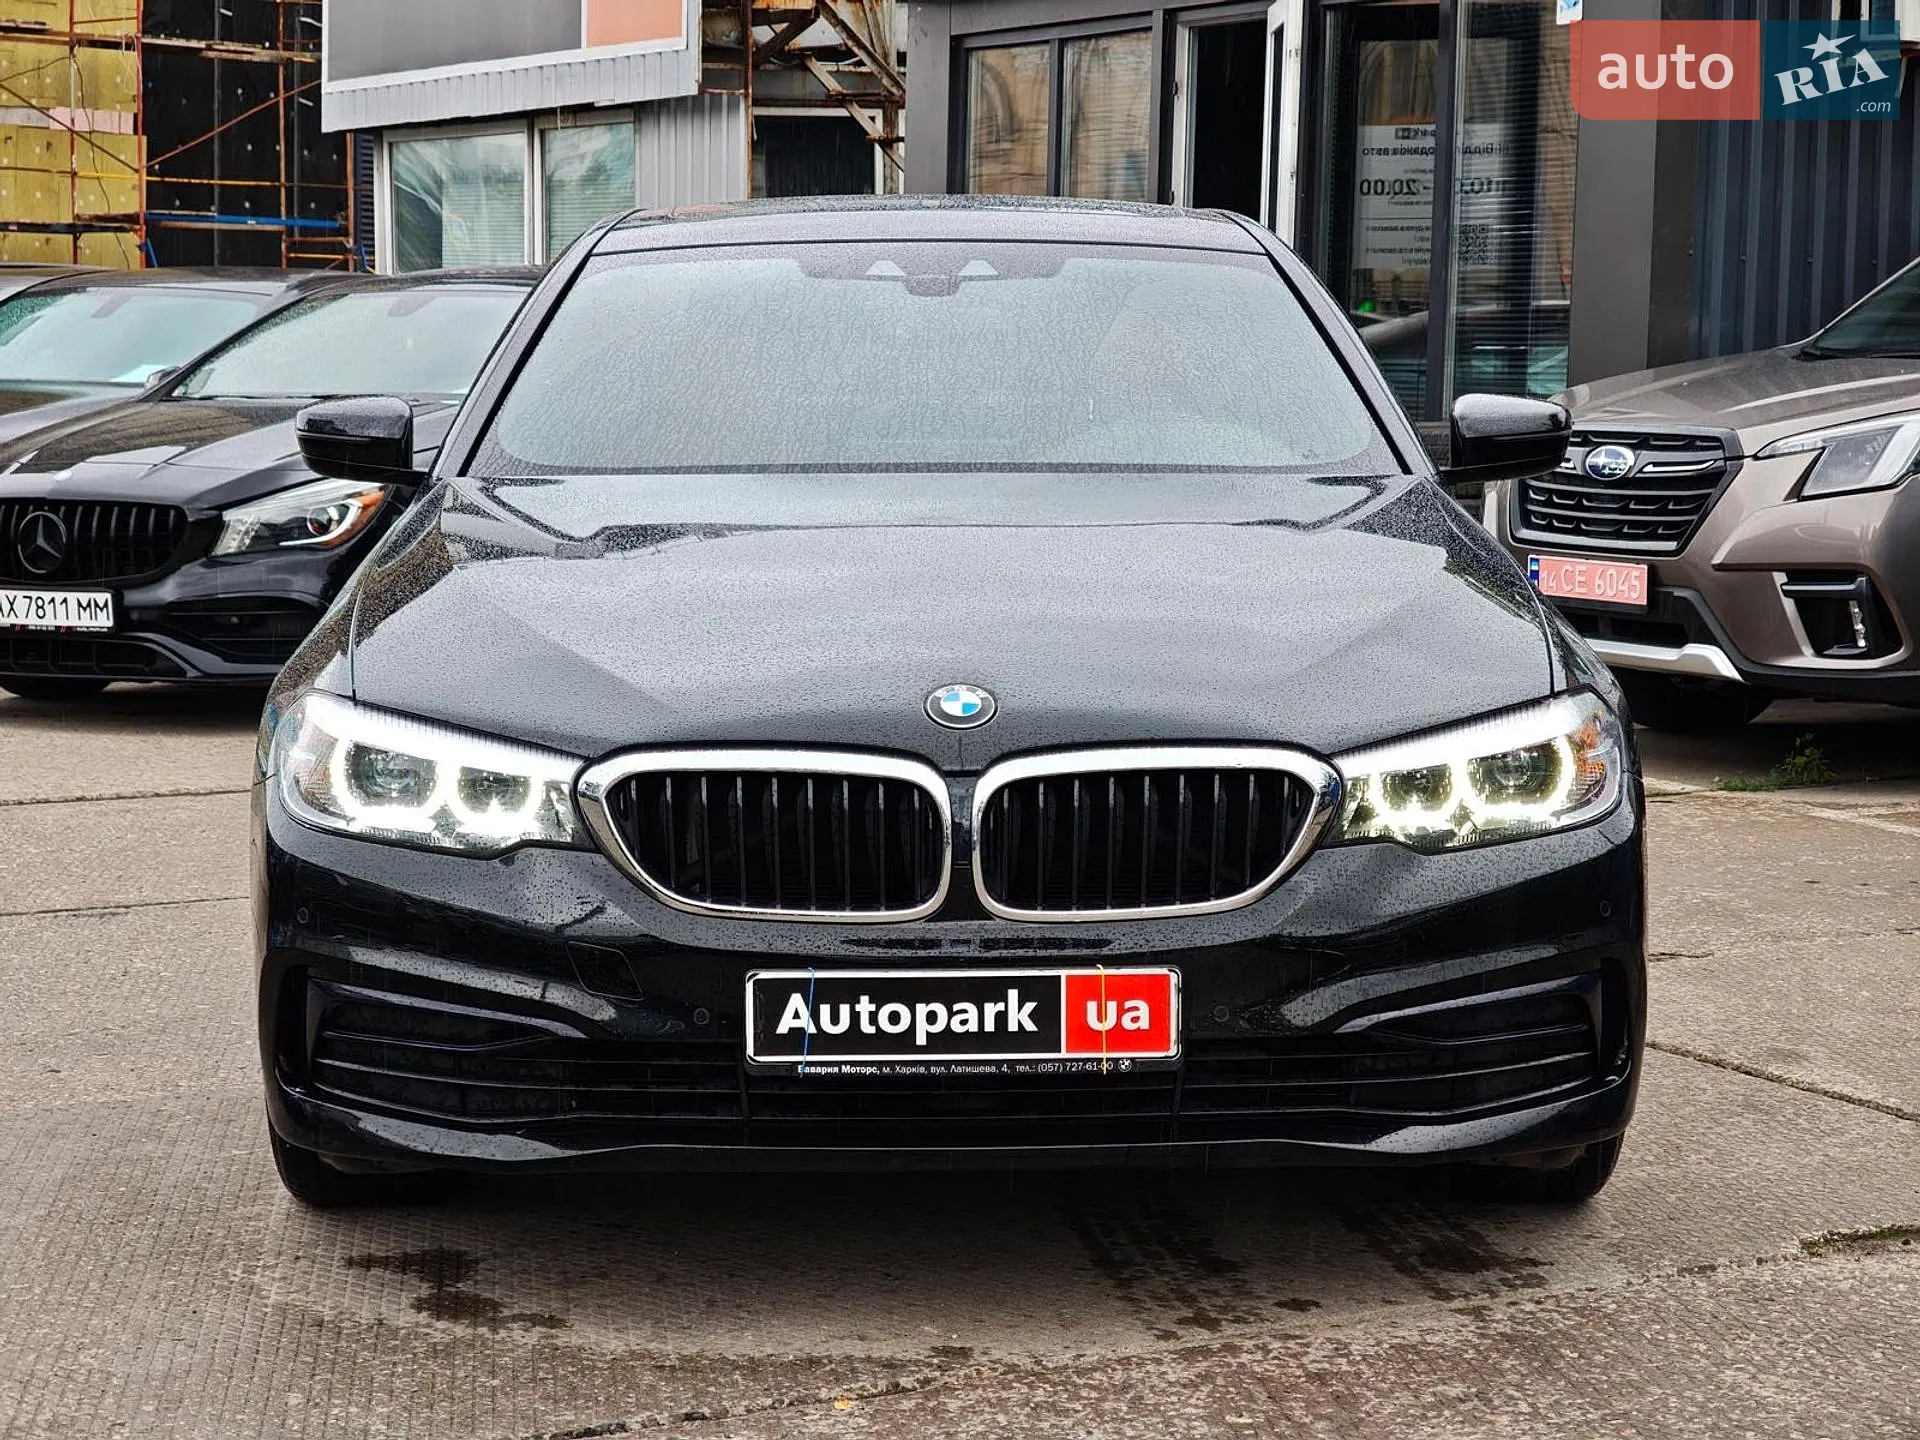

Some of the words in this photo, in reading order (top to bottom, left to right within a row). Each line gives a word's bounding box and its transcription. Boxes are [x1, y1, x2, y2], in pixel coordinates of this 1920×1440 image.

[1541, 569, 1557, 592] 14
[1561, 564, 1589, 593] CE
[1595, 567, 1641, 599] 6045
[23, 595, 69, 620] 7811
[77, 597, 110, 621] MM
[775, 988, 1038, 1046] Autopark
[1086, 999, 1150, 1032] ua
[842, 1065, 880, 1076] Моторс,
[895, 1065, 928, 1075] Харків,
[950, 1064, 999, 1074] Латишева,
[1038, 1062, 1063, 1073] (057)
